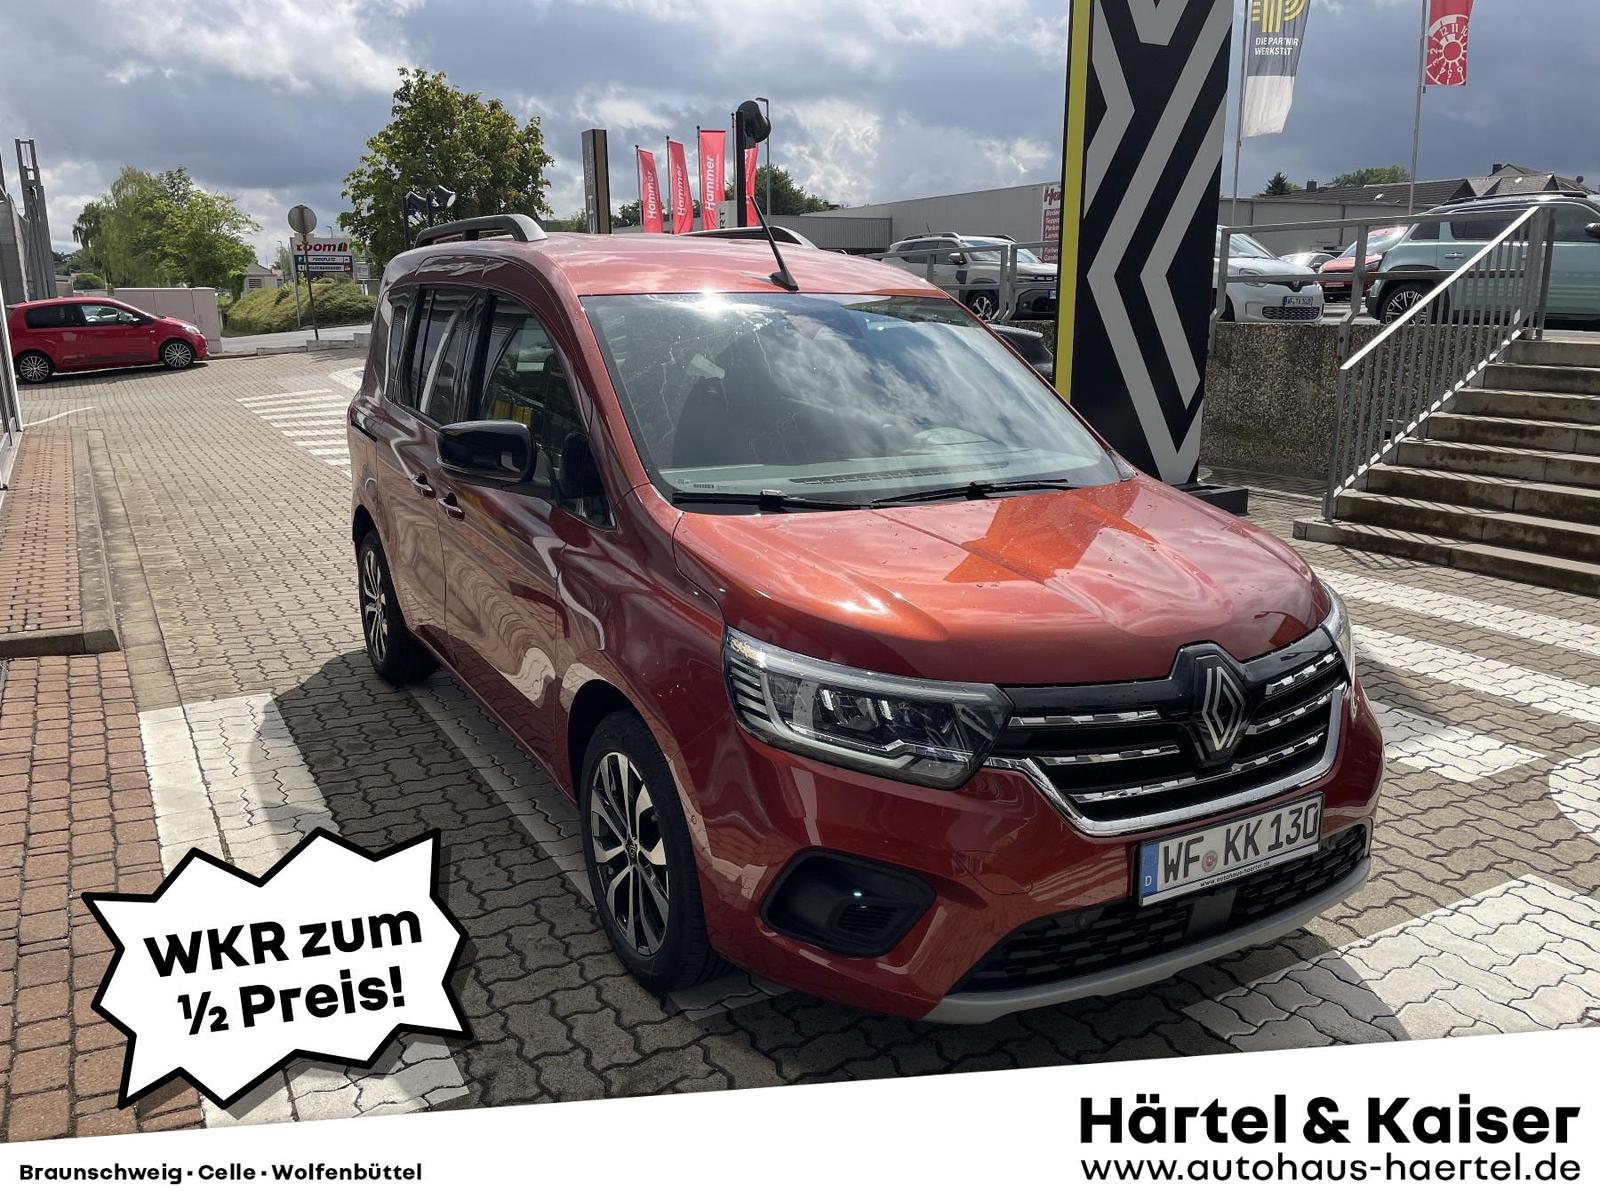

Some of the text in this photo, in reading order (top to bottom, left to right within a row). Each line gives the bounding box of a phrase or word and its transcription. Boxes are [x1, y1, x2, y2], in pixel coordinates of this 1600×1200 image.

[646, 170, 657, 219] Hammer
[706, 155, 716, 211] Hammer
[1164, 802, 1318, 883] WF KK 130
[1145, 875, 1152, 887] D
